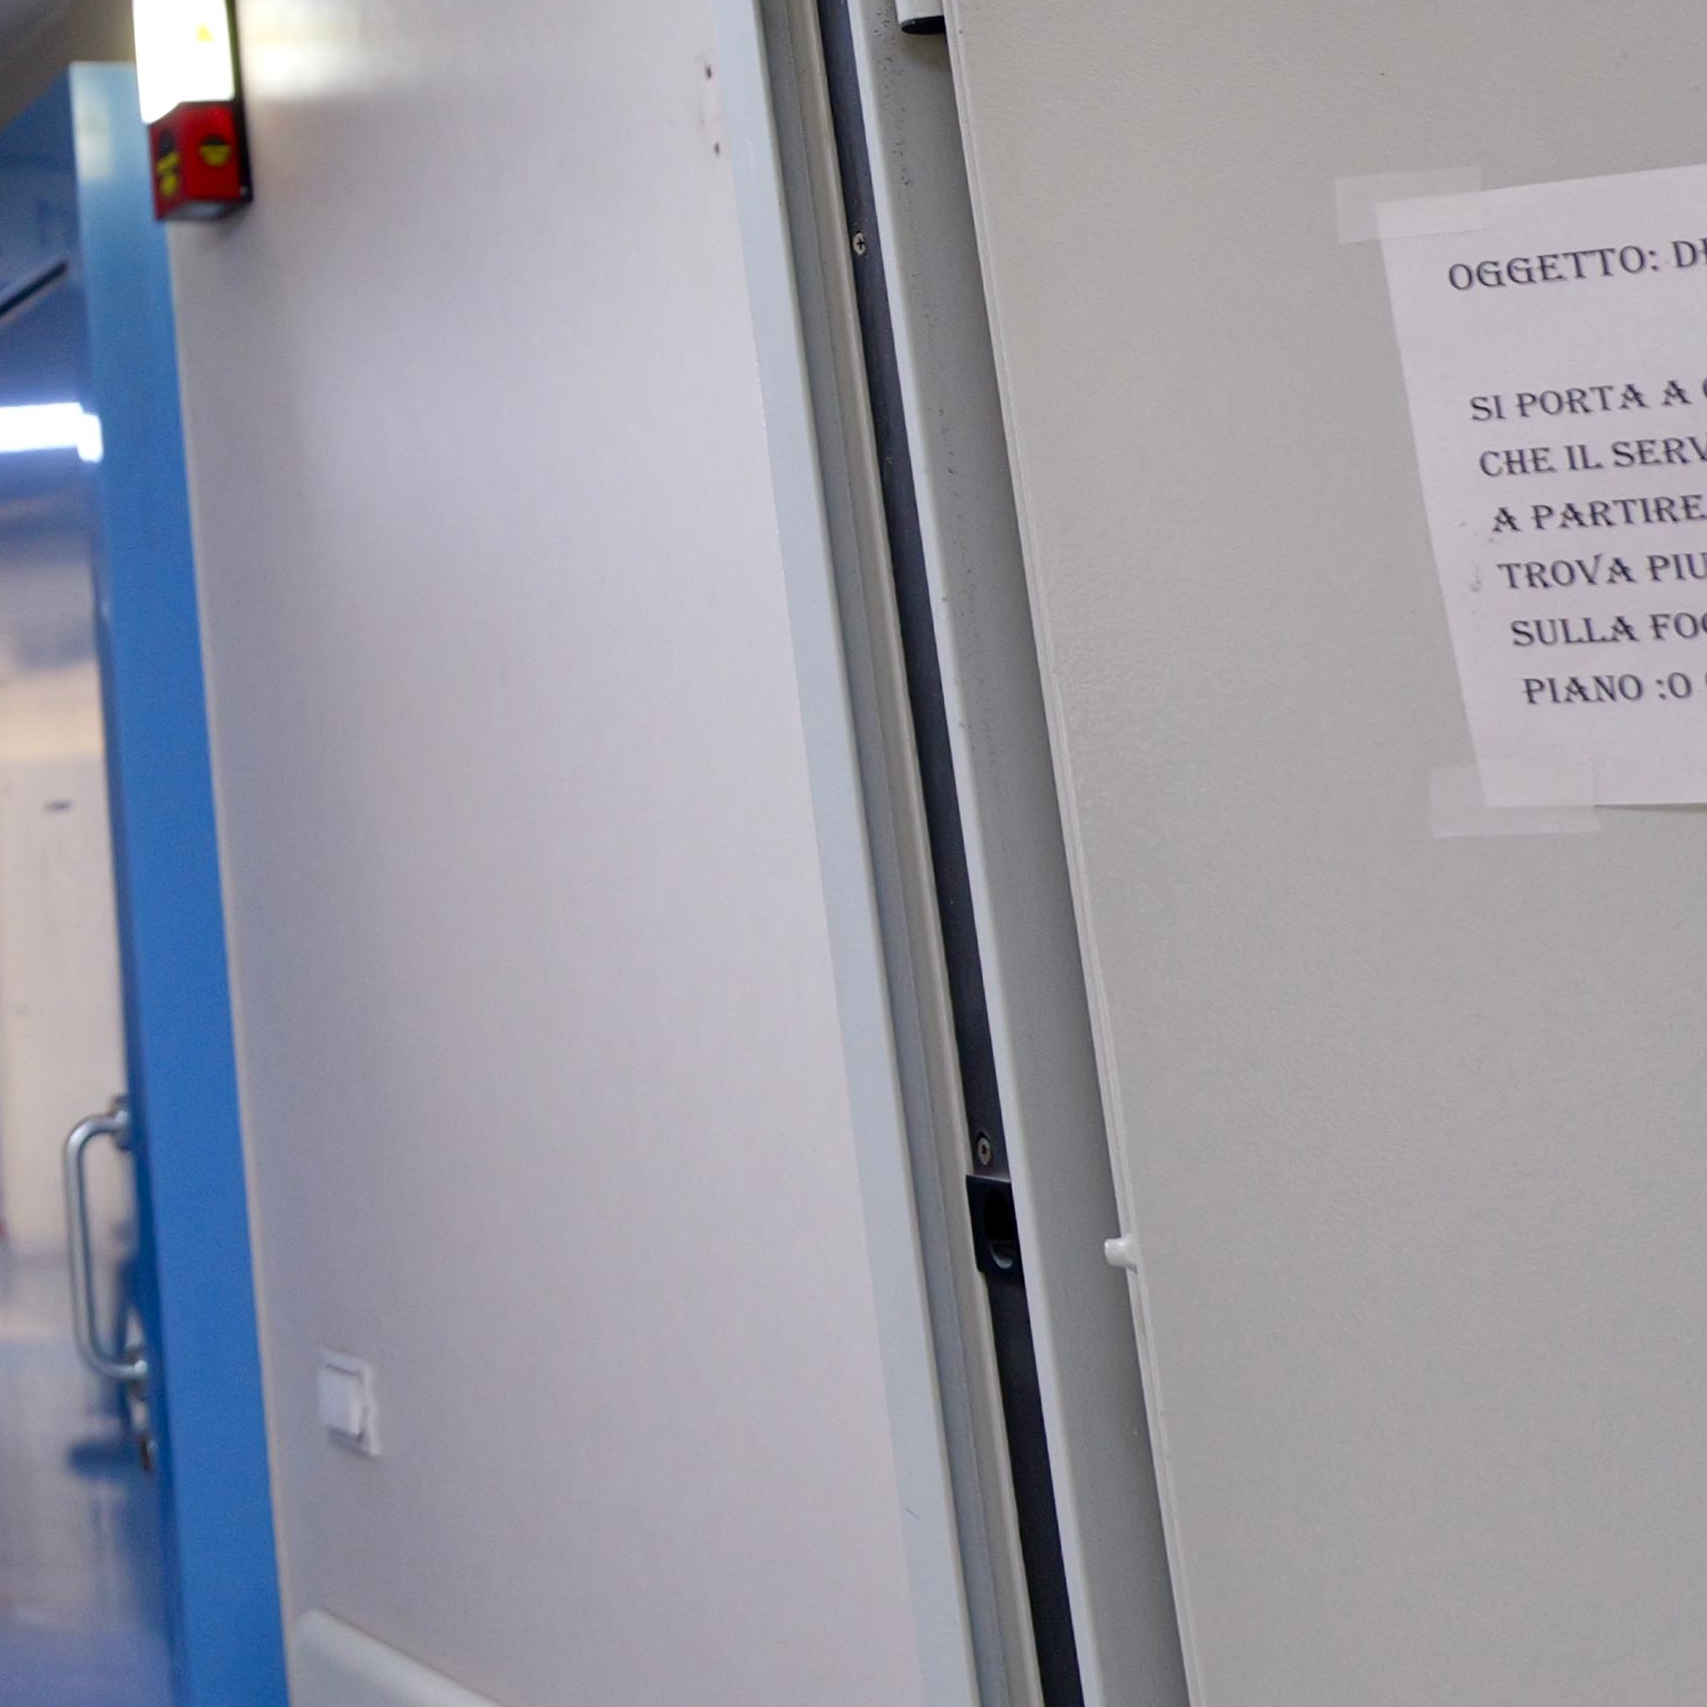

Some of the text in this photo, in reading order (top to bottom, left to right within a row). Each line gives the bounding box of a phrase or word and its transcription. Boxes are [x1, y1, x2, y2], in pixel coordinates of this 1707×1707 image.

[1448, 237, 1707, 291] OGGETTO: D
[1469, 394, 1506, 421] SI
[1516, 383, 1649, 418] PORTA
[1662, 379, 1692, 407] A
[1479, 447, 1556, 478] CHE
[1564, 444, 1605, 471] IL
[1492, 494, 1707, 533] A PARTIRE
[1497, 552, 1638, 590] TROVA
[1510, 610, 1707, 647] SULLA FO
[1522, 673, 1644, 705] PIANO
